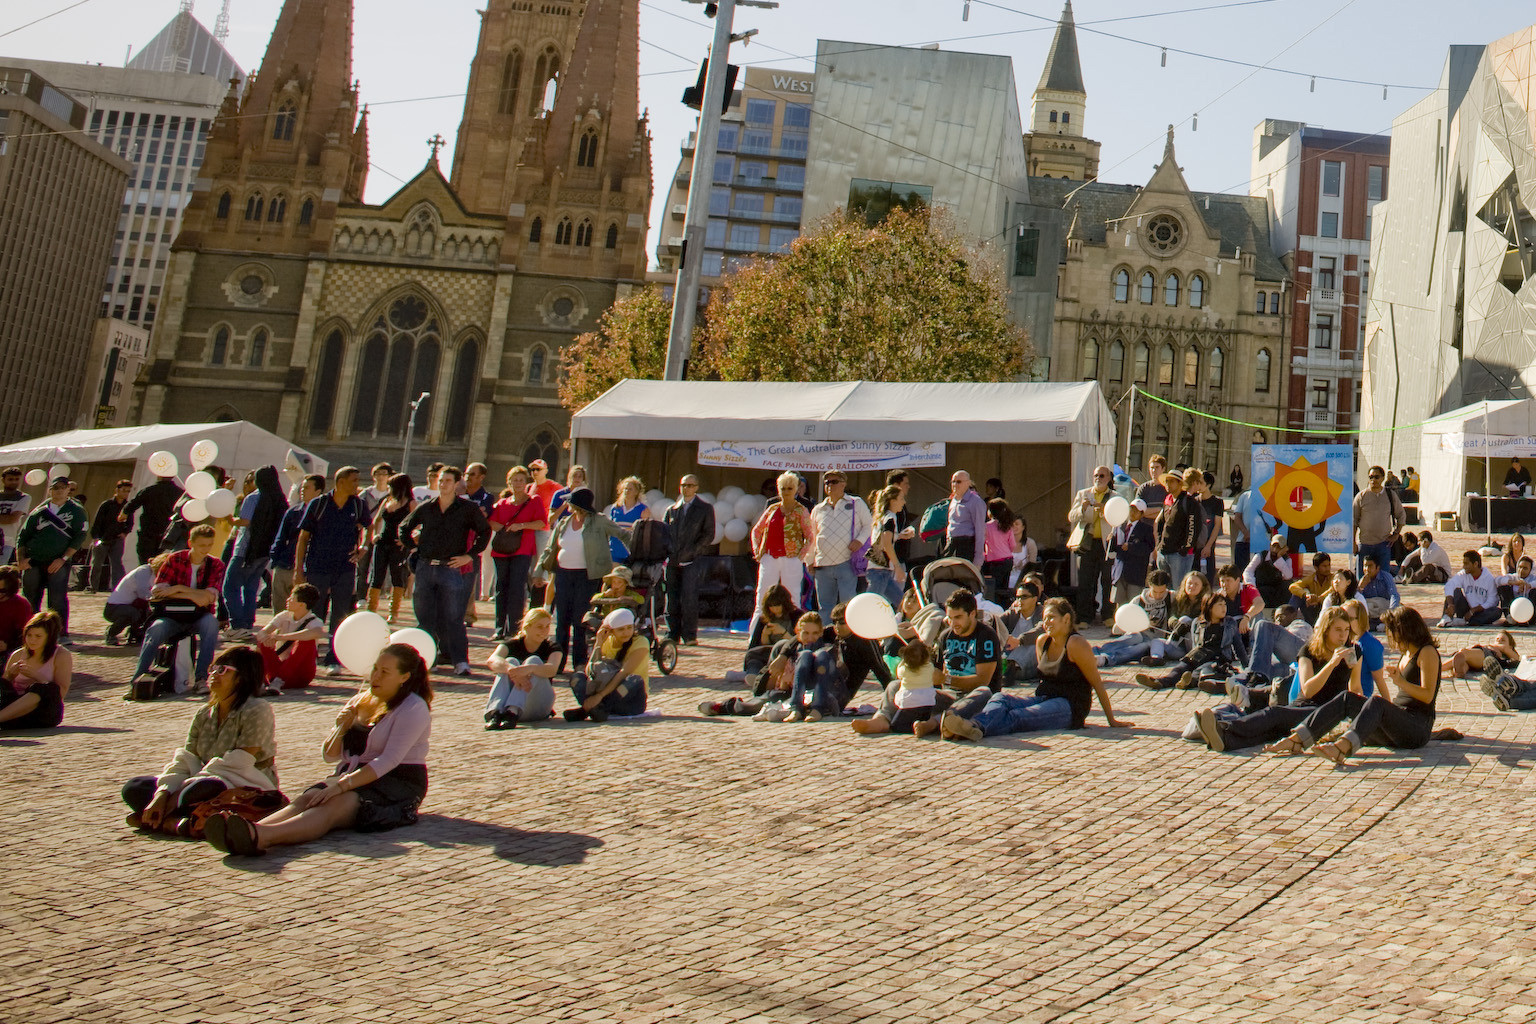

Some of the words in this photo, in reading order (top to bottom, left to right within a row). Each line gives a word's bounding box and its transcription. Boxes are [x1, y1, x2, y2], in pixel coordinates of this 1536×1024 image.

[747, 447, 766, 456] The
[768, 445, 795, 455] Great
[798, 442, 848, 454] Australian
[851, 440, 882, 452] Sunny
[762, 459, 782, 468] FACE
[784, 461, 825, 470] PAINTING
[836, 462, 880, 470] BALLOONS
[984, 639, 994, 658] 9
